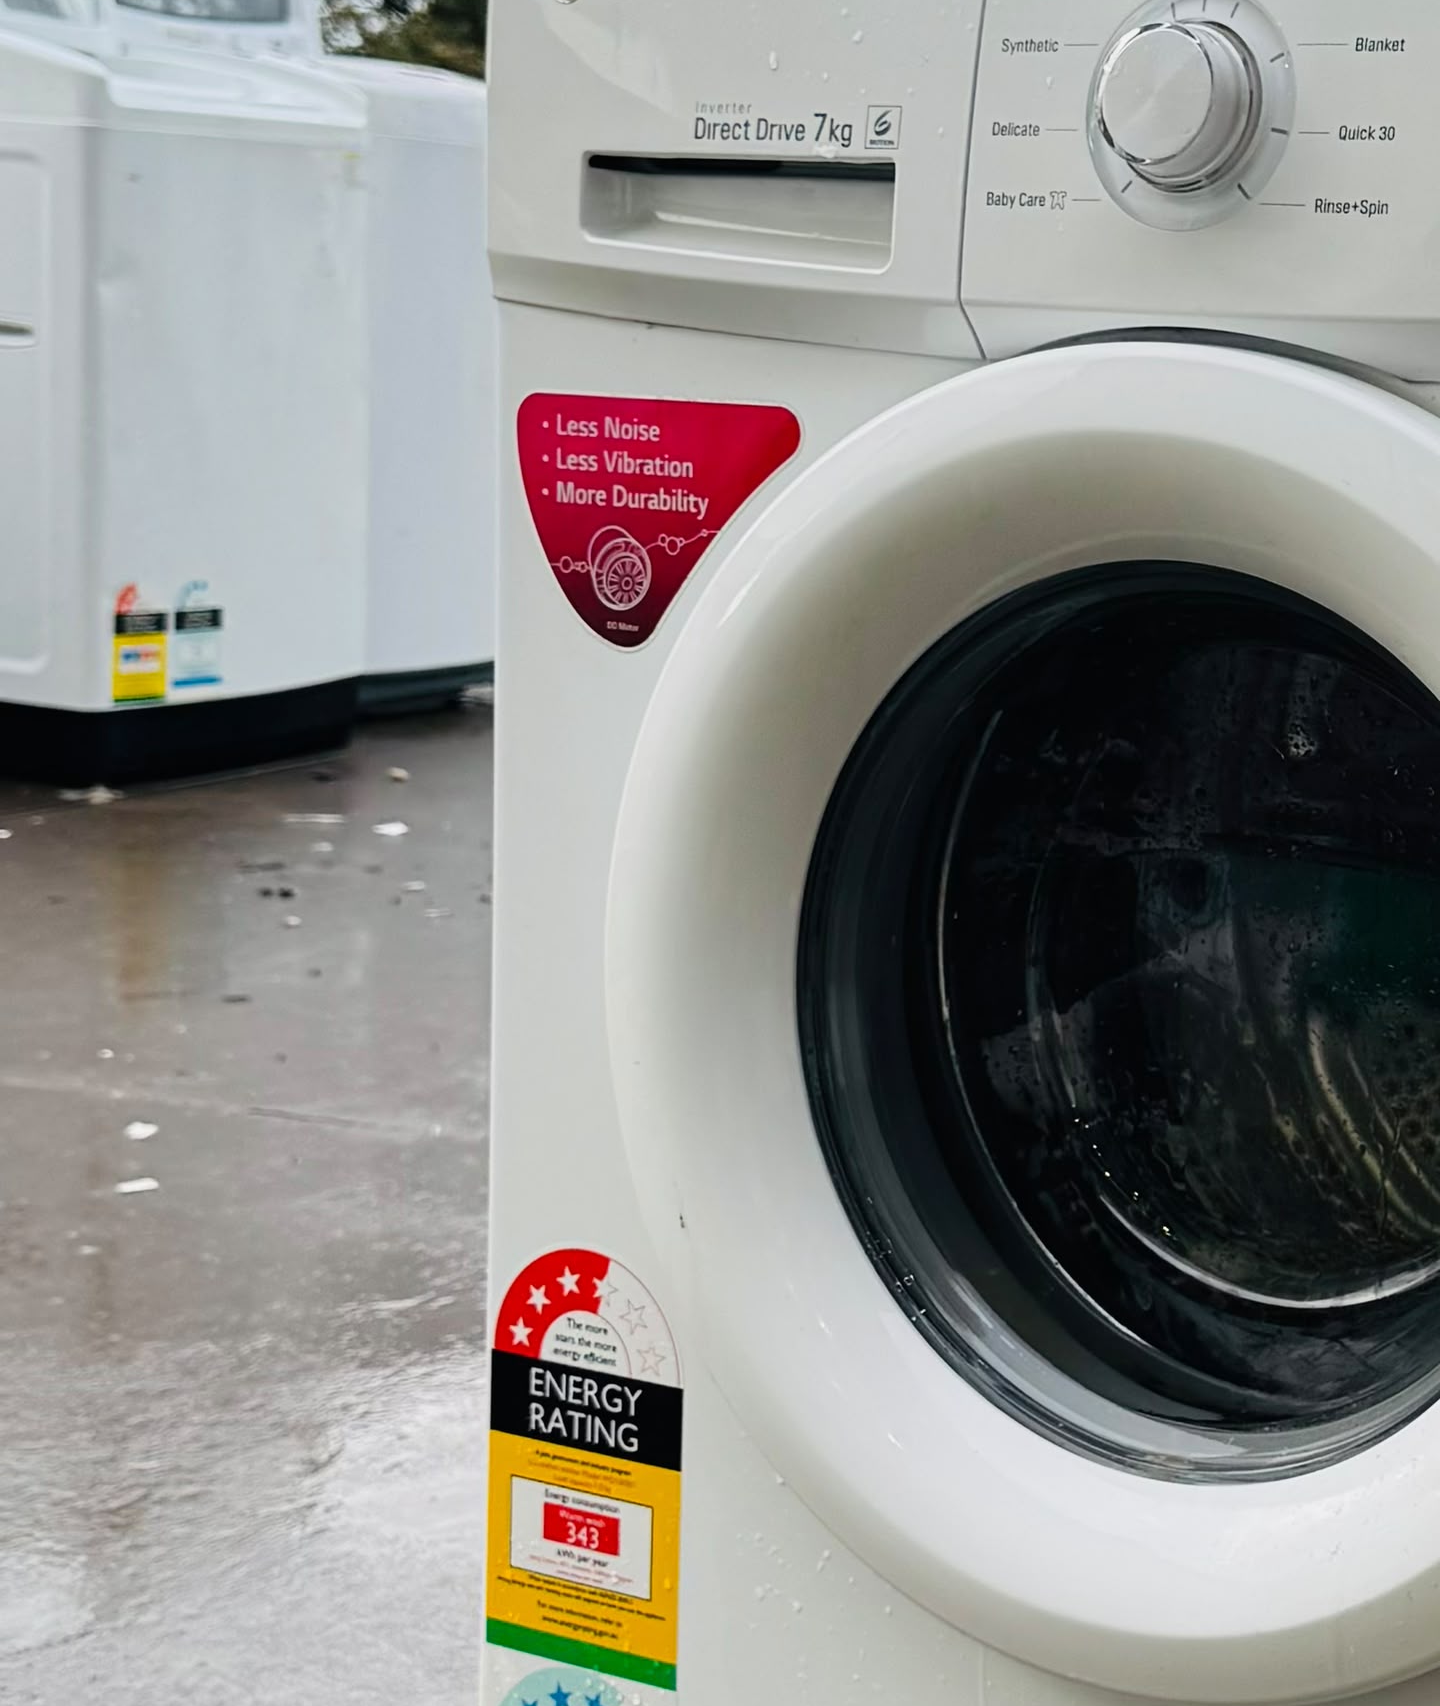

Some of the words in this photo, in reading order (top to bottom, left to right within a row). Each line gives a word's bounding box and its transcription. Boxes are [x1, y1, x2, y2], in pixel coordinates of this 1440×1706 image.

[1001, 38, 1059, 55] Synthetic
[1355, 36, 1405, 53] Blanket
[695, 102, 752, 115] Inverter
[694, 117, 751, 141] Direct
[756, 118, 805, 142] Drive
[991, 122, 1041, 138] Delicate
[1338, 125, 1376, 142] Quick
[1378, 125, 1396, 141] 30
[986, 192, 1016, 210] Baby
[1018, 192, 1046, 208] Care
[1314, 198, 1389, 218] Rinse+Spin
[556, 413, 599, 438] Less
[604, 416, 660, 442] Noise
[556, 447, 598, 472] Less
[603, 450, 694, 478] Vibration
[556, 481, 607, 506] More
[612, 484, 709, 520] Durability
[566, 1317, 583, 1330] The
[585, 1324, 608, 1336] more
[578, 1336, 591, 1348] the
[594, 1341, 617, 1353] more
[529, 1367, 642, 1417] ENERGY
[529, 1403, 639, 1453] RATING
[566, 1521, 599, 1550] 343
